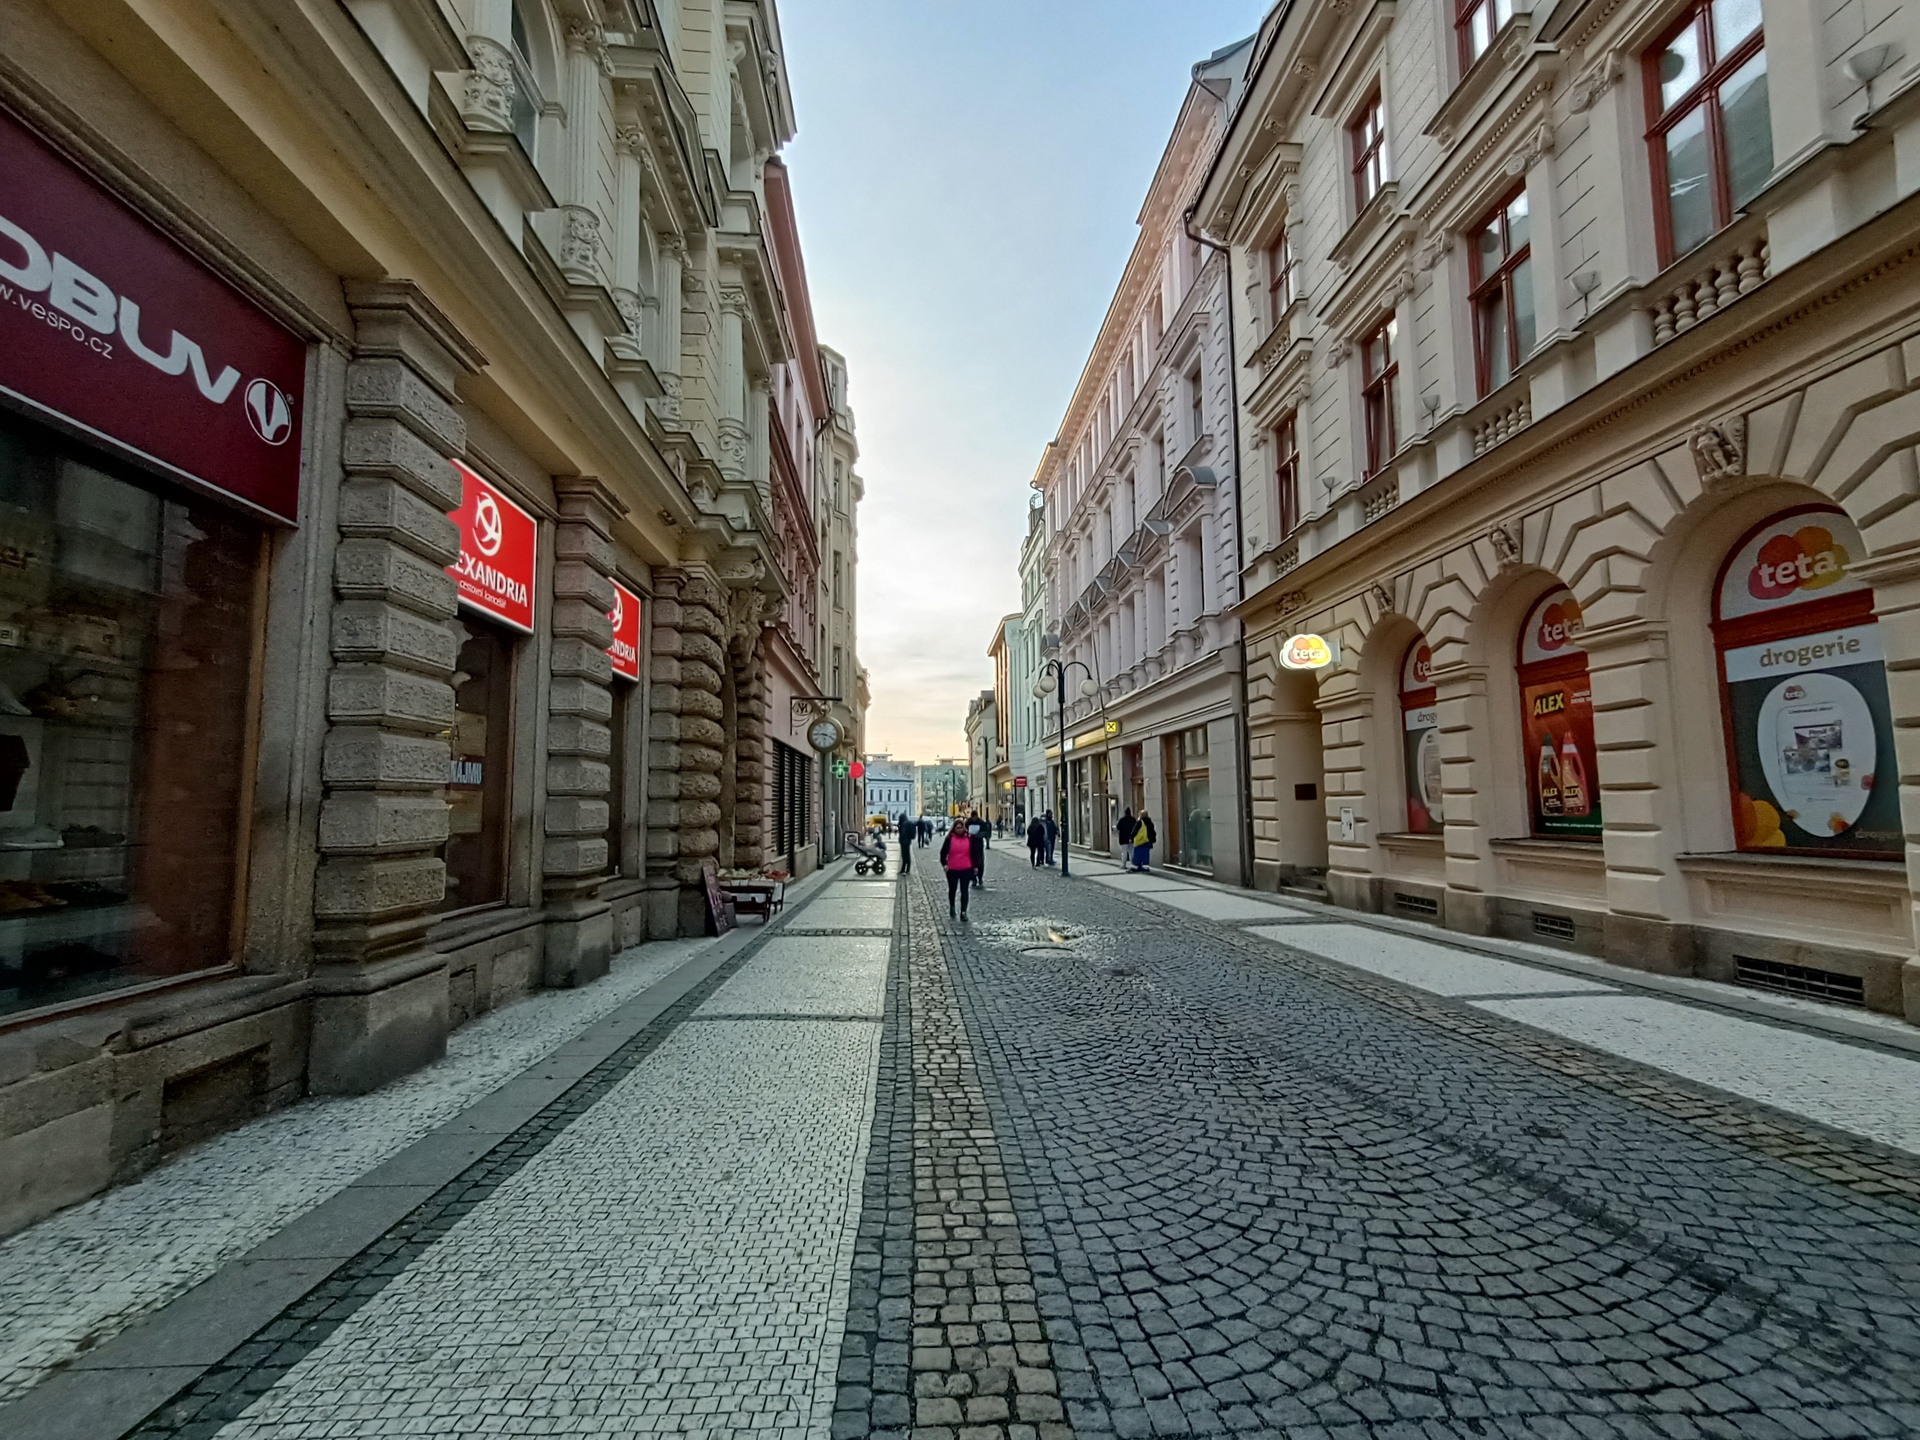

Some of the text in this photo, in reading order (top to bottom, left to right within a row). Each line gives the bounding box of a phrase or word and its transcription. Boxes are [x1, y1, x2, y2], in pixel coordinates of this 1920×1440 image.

[448, 550, 528, 608] EXANDRIA
[1759, 549, 1838, 588] teta
[1543, 617, 1585, 643] teta
[1292, 647, 1326, 660] teta
[1760, 635, 1861, 667] drogerie
[1534, 692, 1565, 716] ALEX
